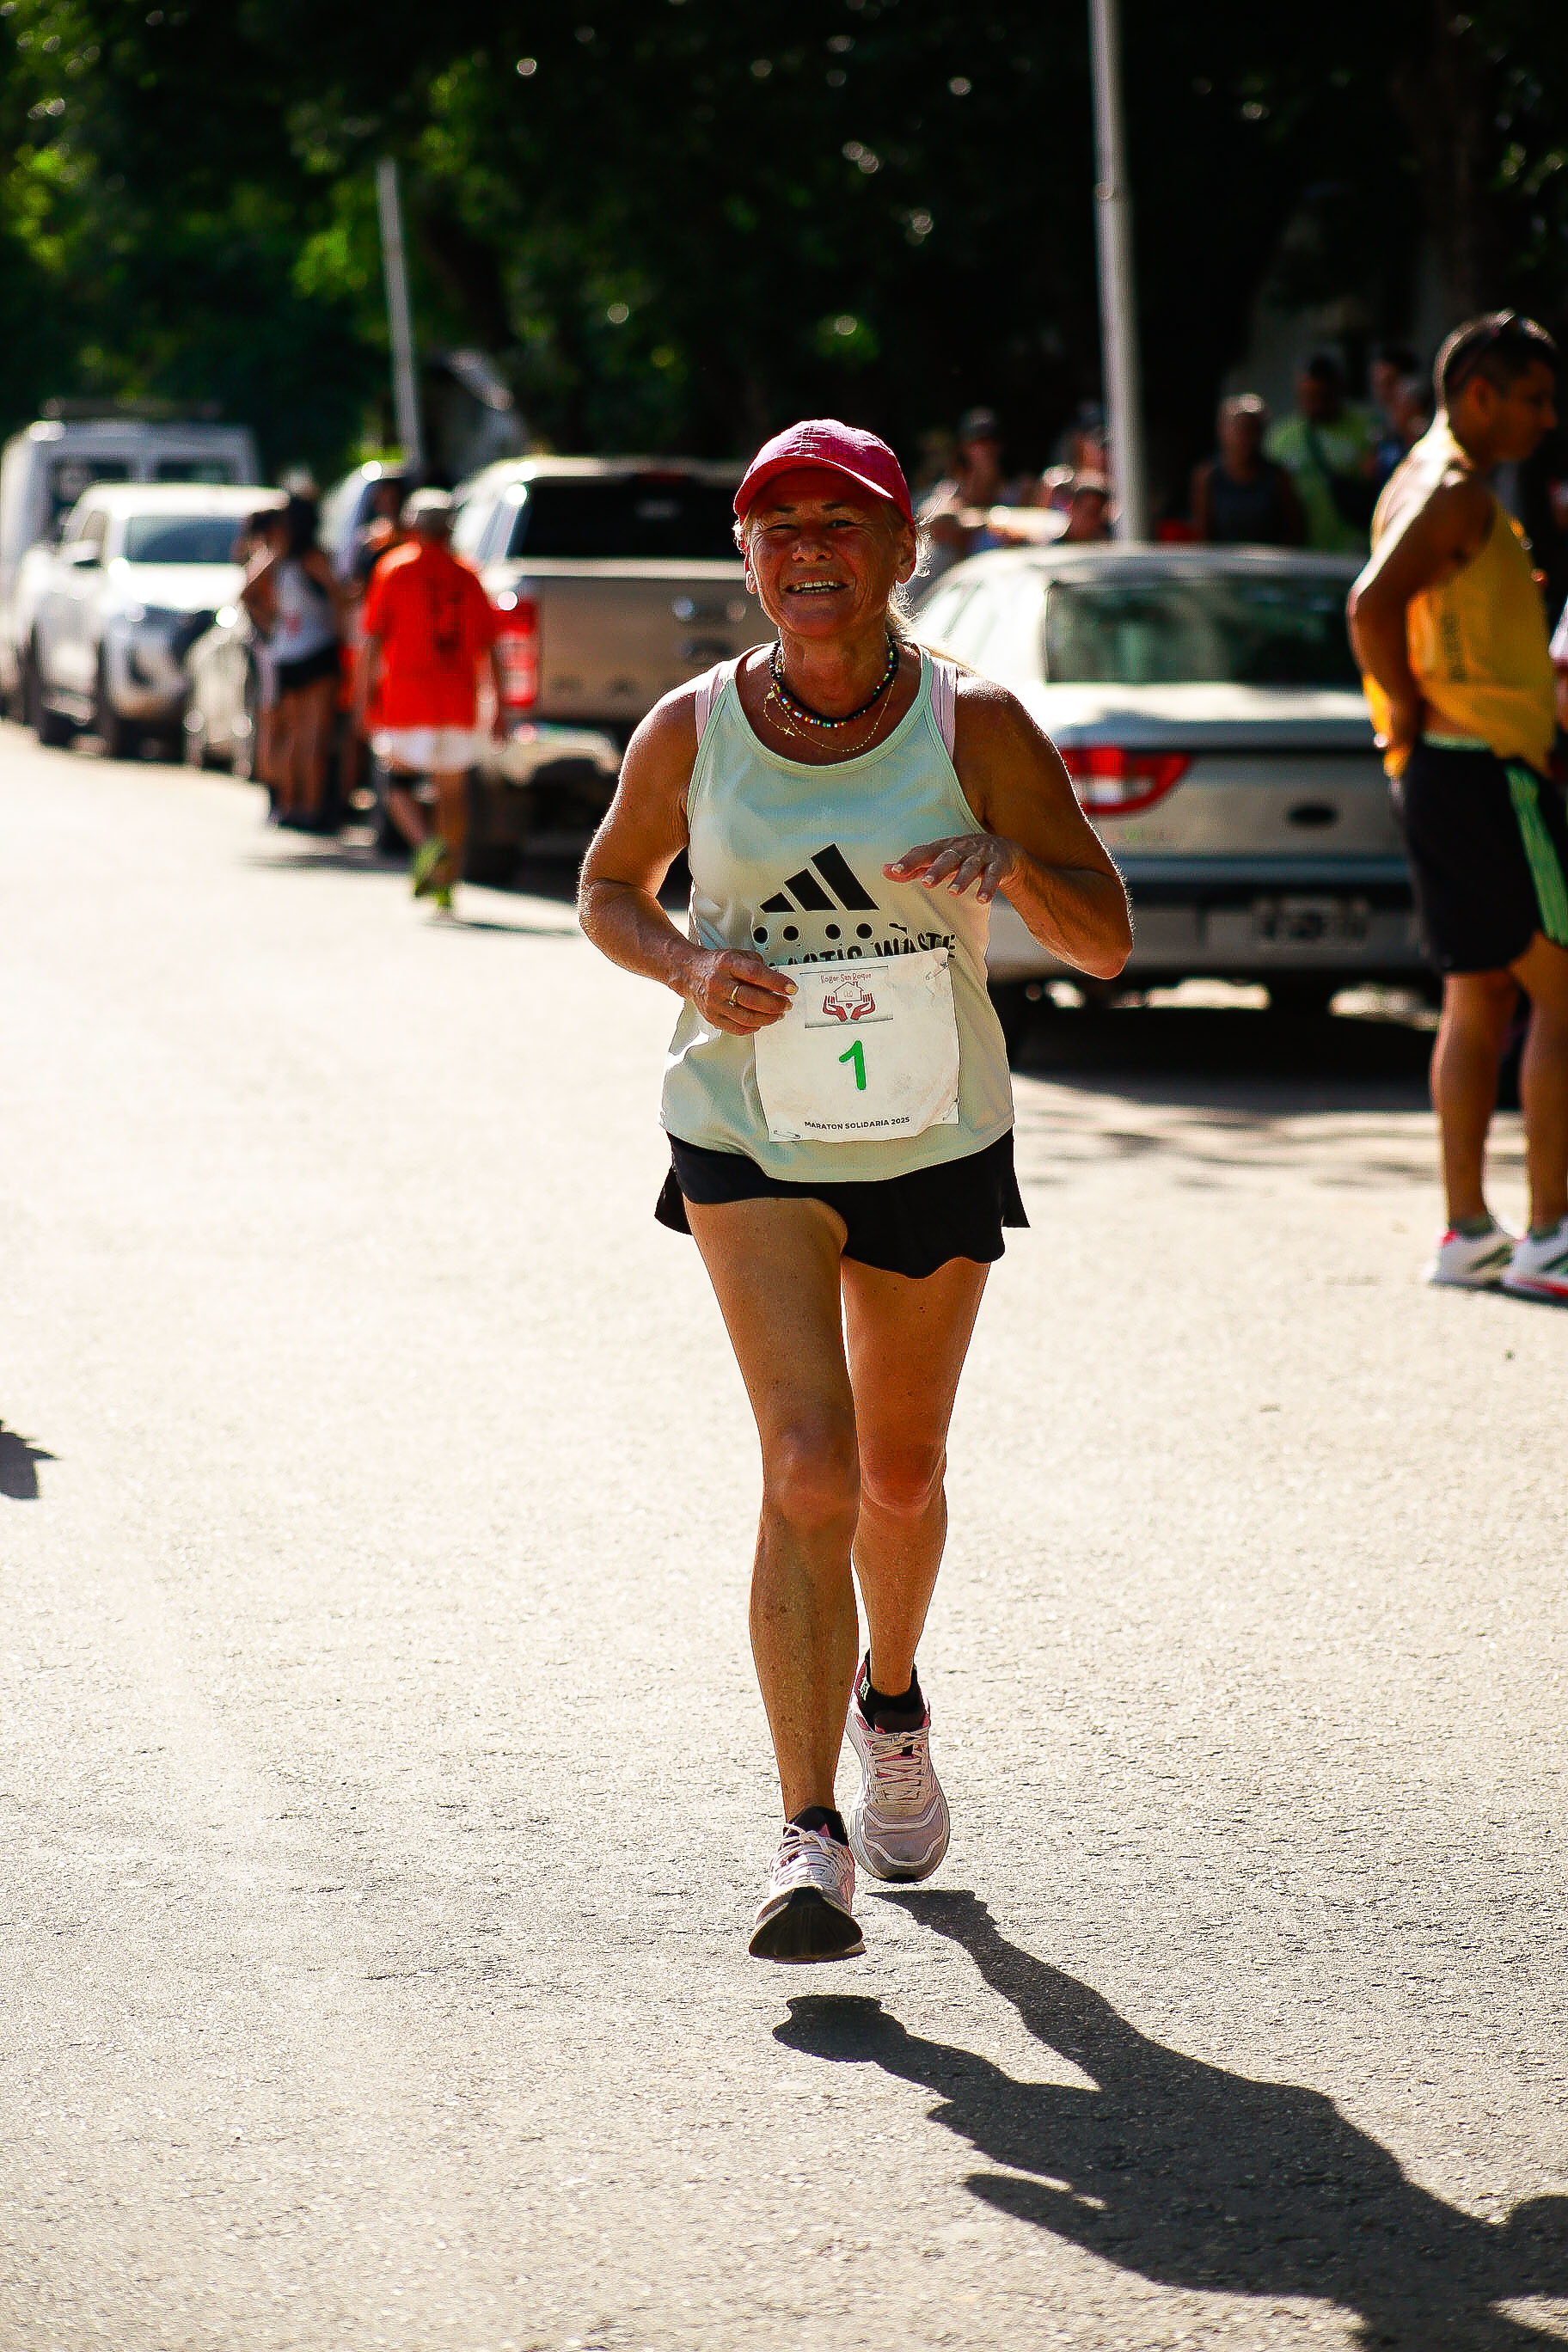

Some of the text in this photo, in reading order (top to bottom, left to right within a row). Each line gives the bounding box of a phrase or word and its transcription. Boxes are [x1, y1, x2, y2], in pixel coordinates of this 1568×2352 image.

[840, 972, 852, 982] San
[838, 1039, 867, 1091] 1
[804, 1116, 910, 1130] MARATON SOLIDARIA 2025
